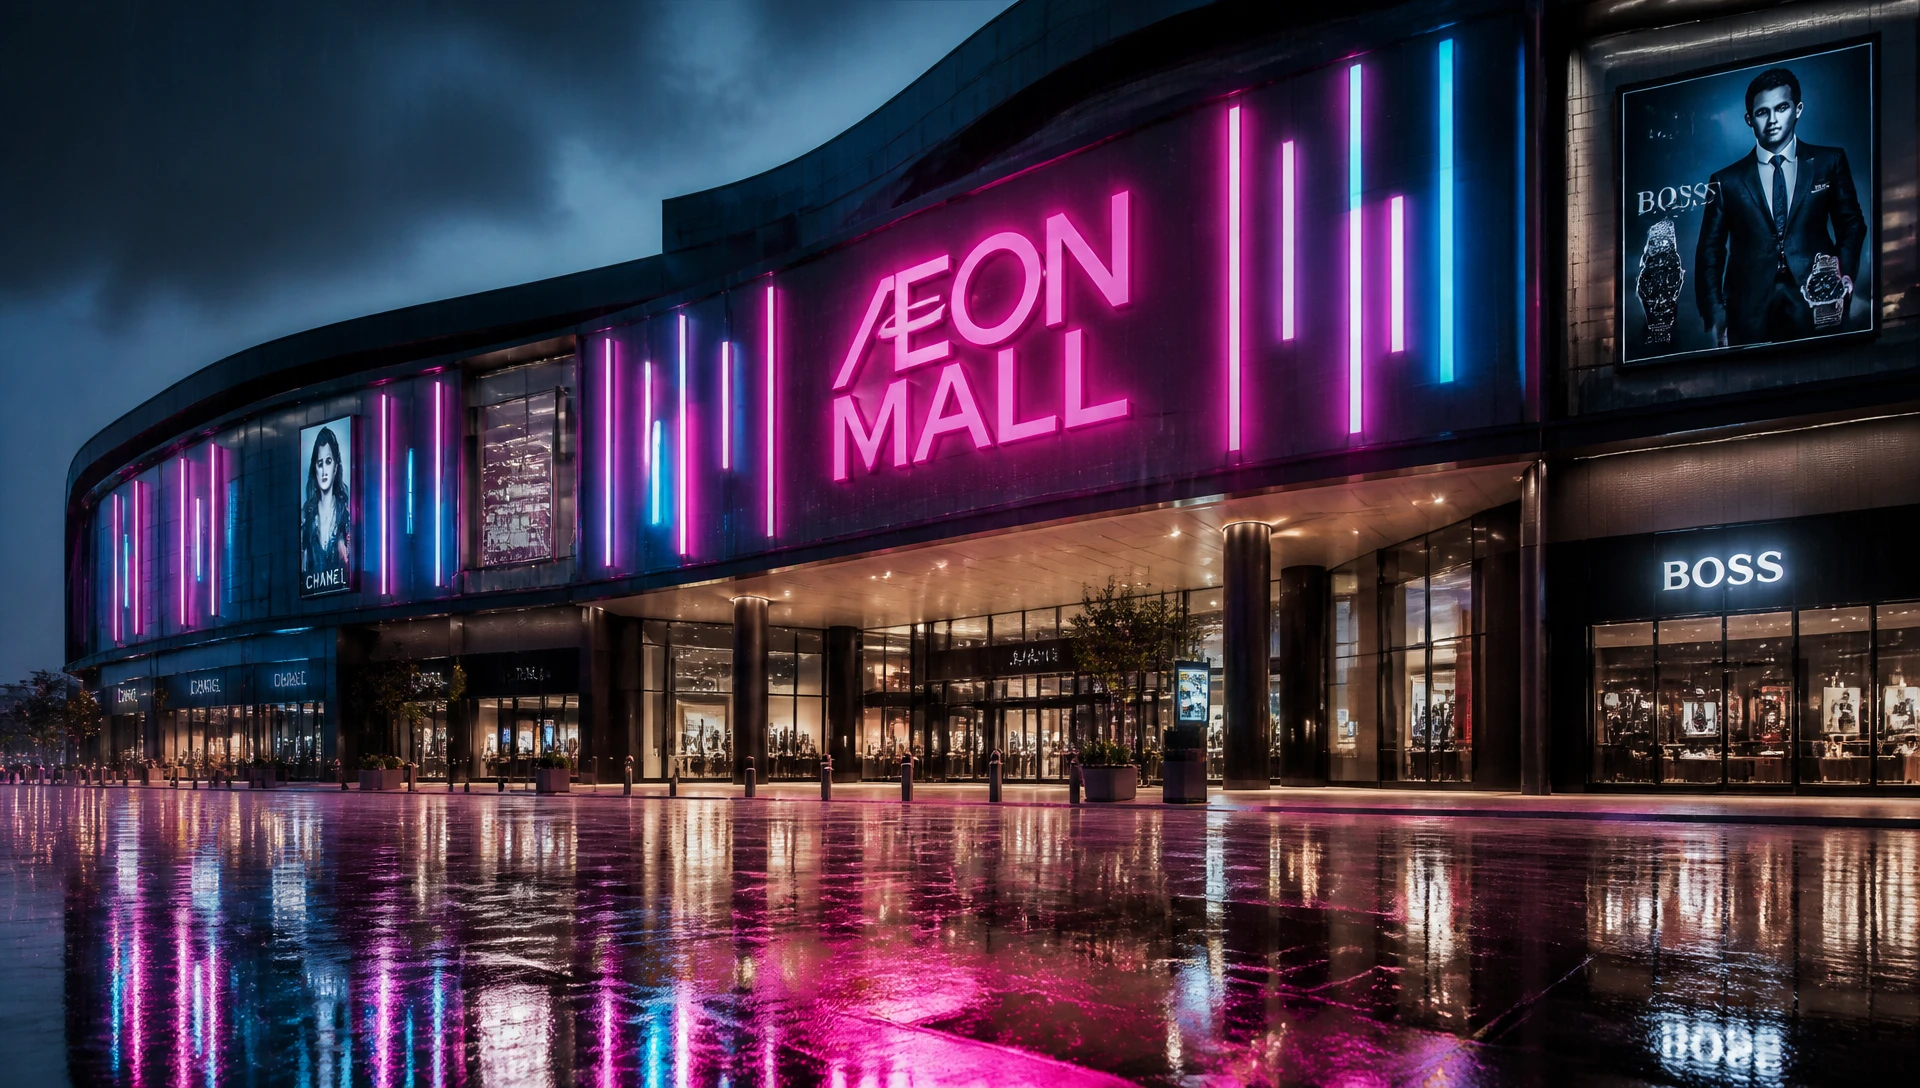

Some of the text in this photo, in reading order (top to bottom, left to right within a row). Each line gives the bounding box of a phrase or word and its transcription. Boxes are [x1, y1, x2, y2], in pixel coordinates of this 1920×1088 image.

[833, 329, 1130, 481] MALL
[306, 568, 347, 589] CHANEL
[1663, 550, 1784, 591] BOSS
